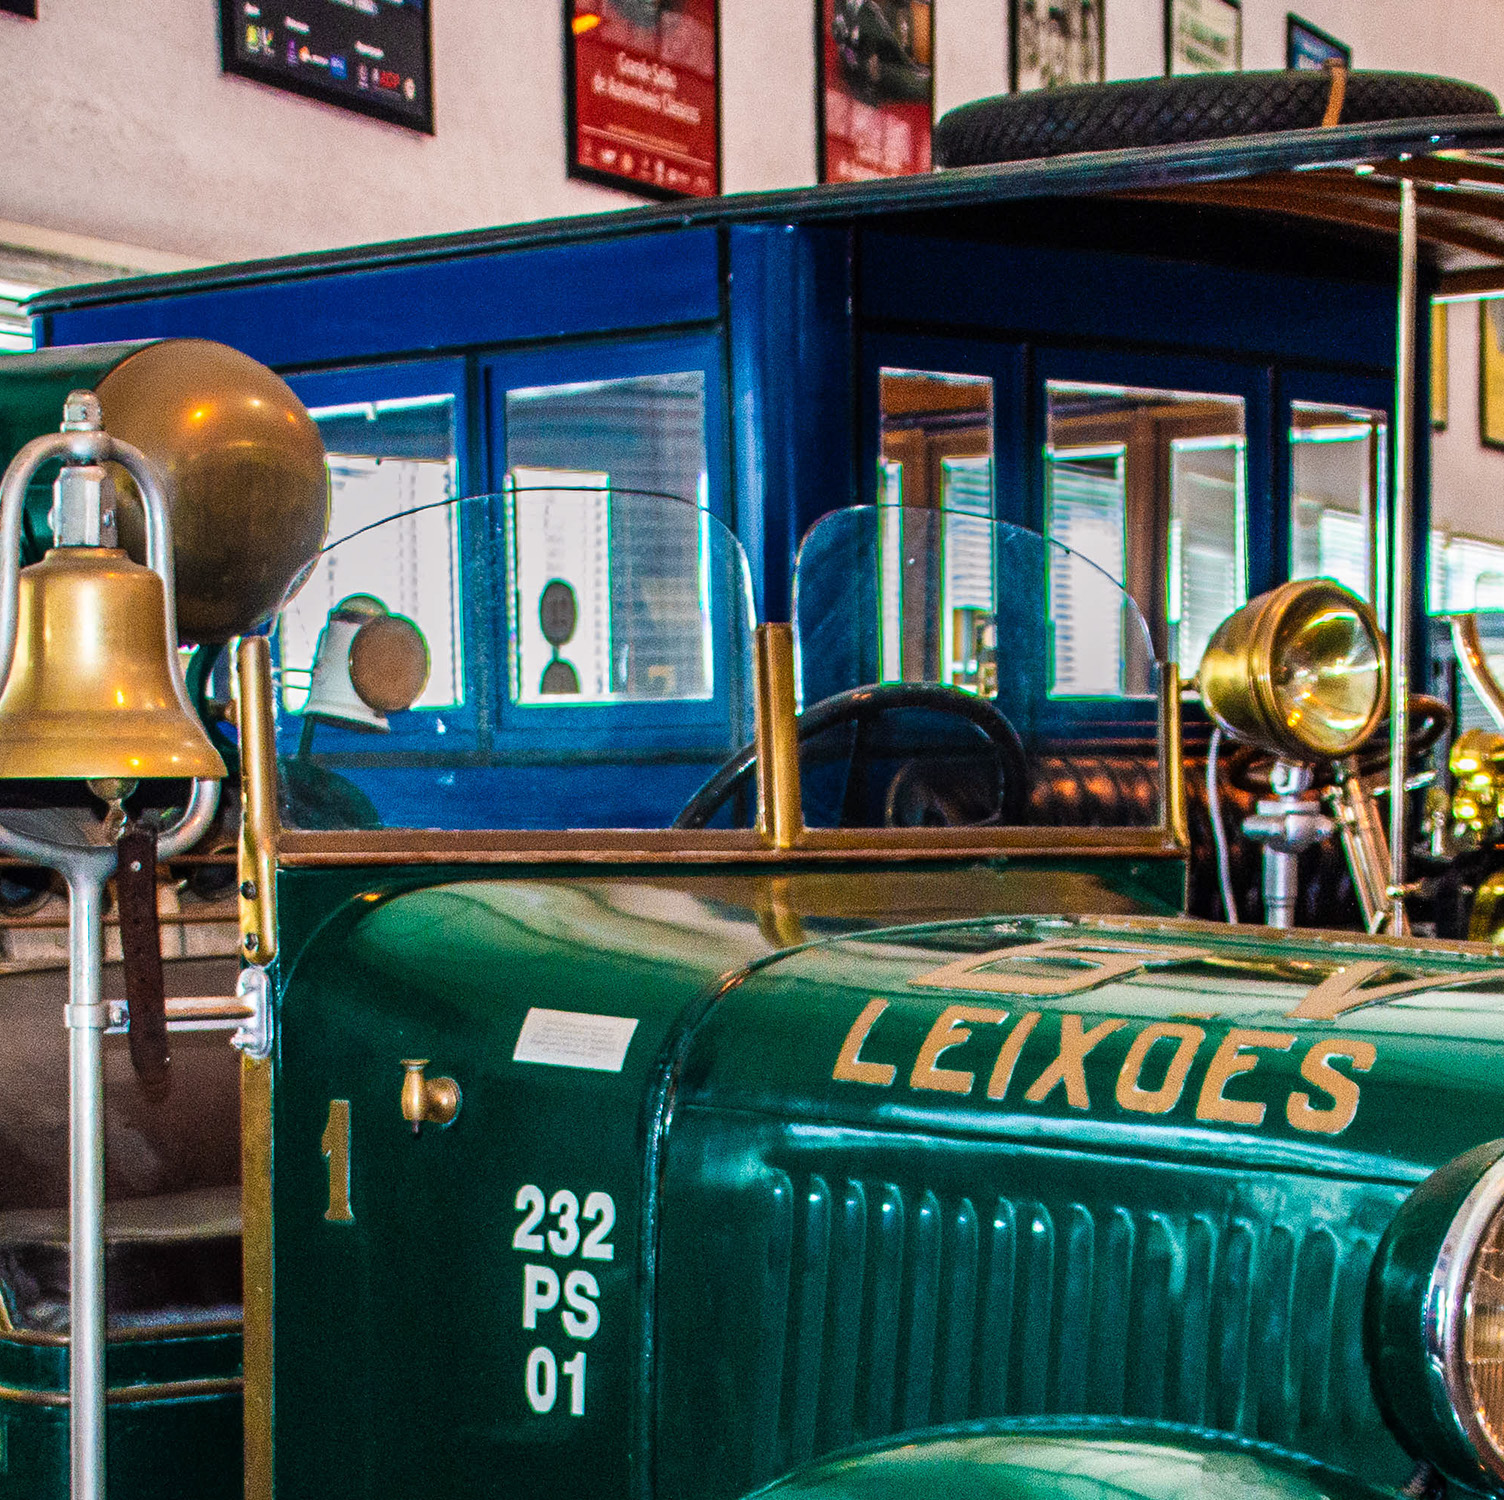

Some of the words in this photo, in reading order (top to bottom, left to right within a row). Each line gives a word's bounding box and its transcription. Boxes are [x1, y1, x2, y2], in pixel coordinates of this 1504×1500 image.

[512, 1185, 616, 1260] 232
[522, 1265, 601, 1341] PS
[525, 1346, 588, 1416] 01
